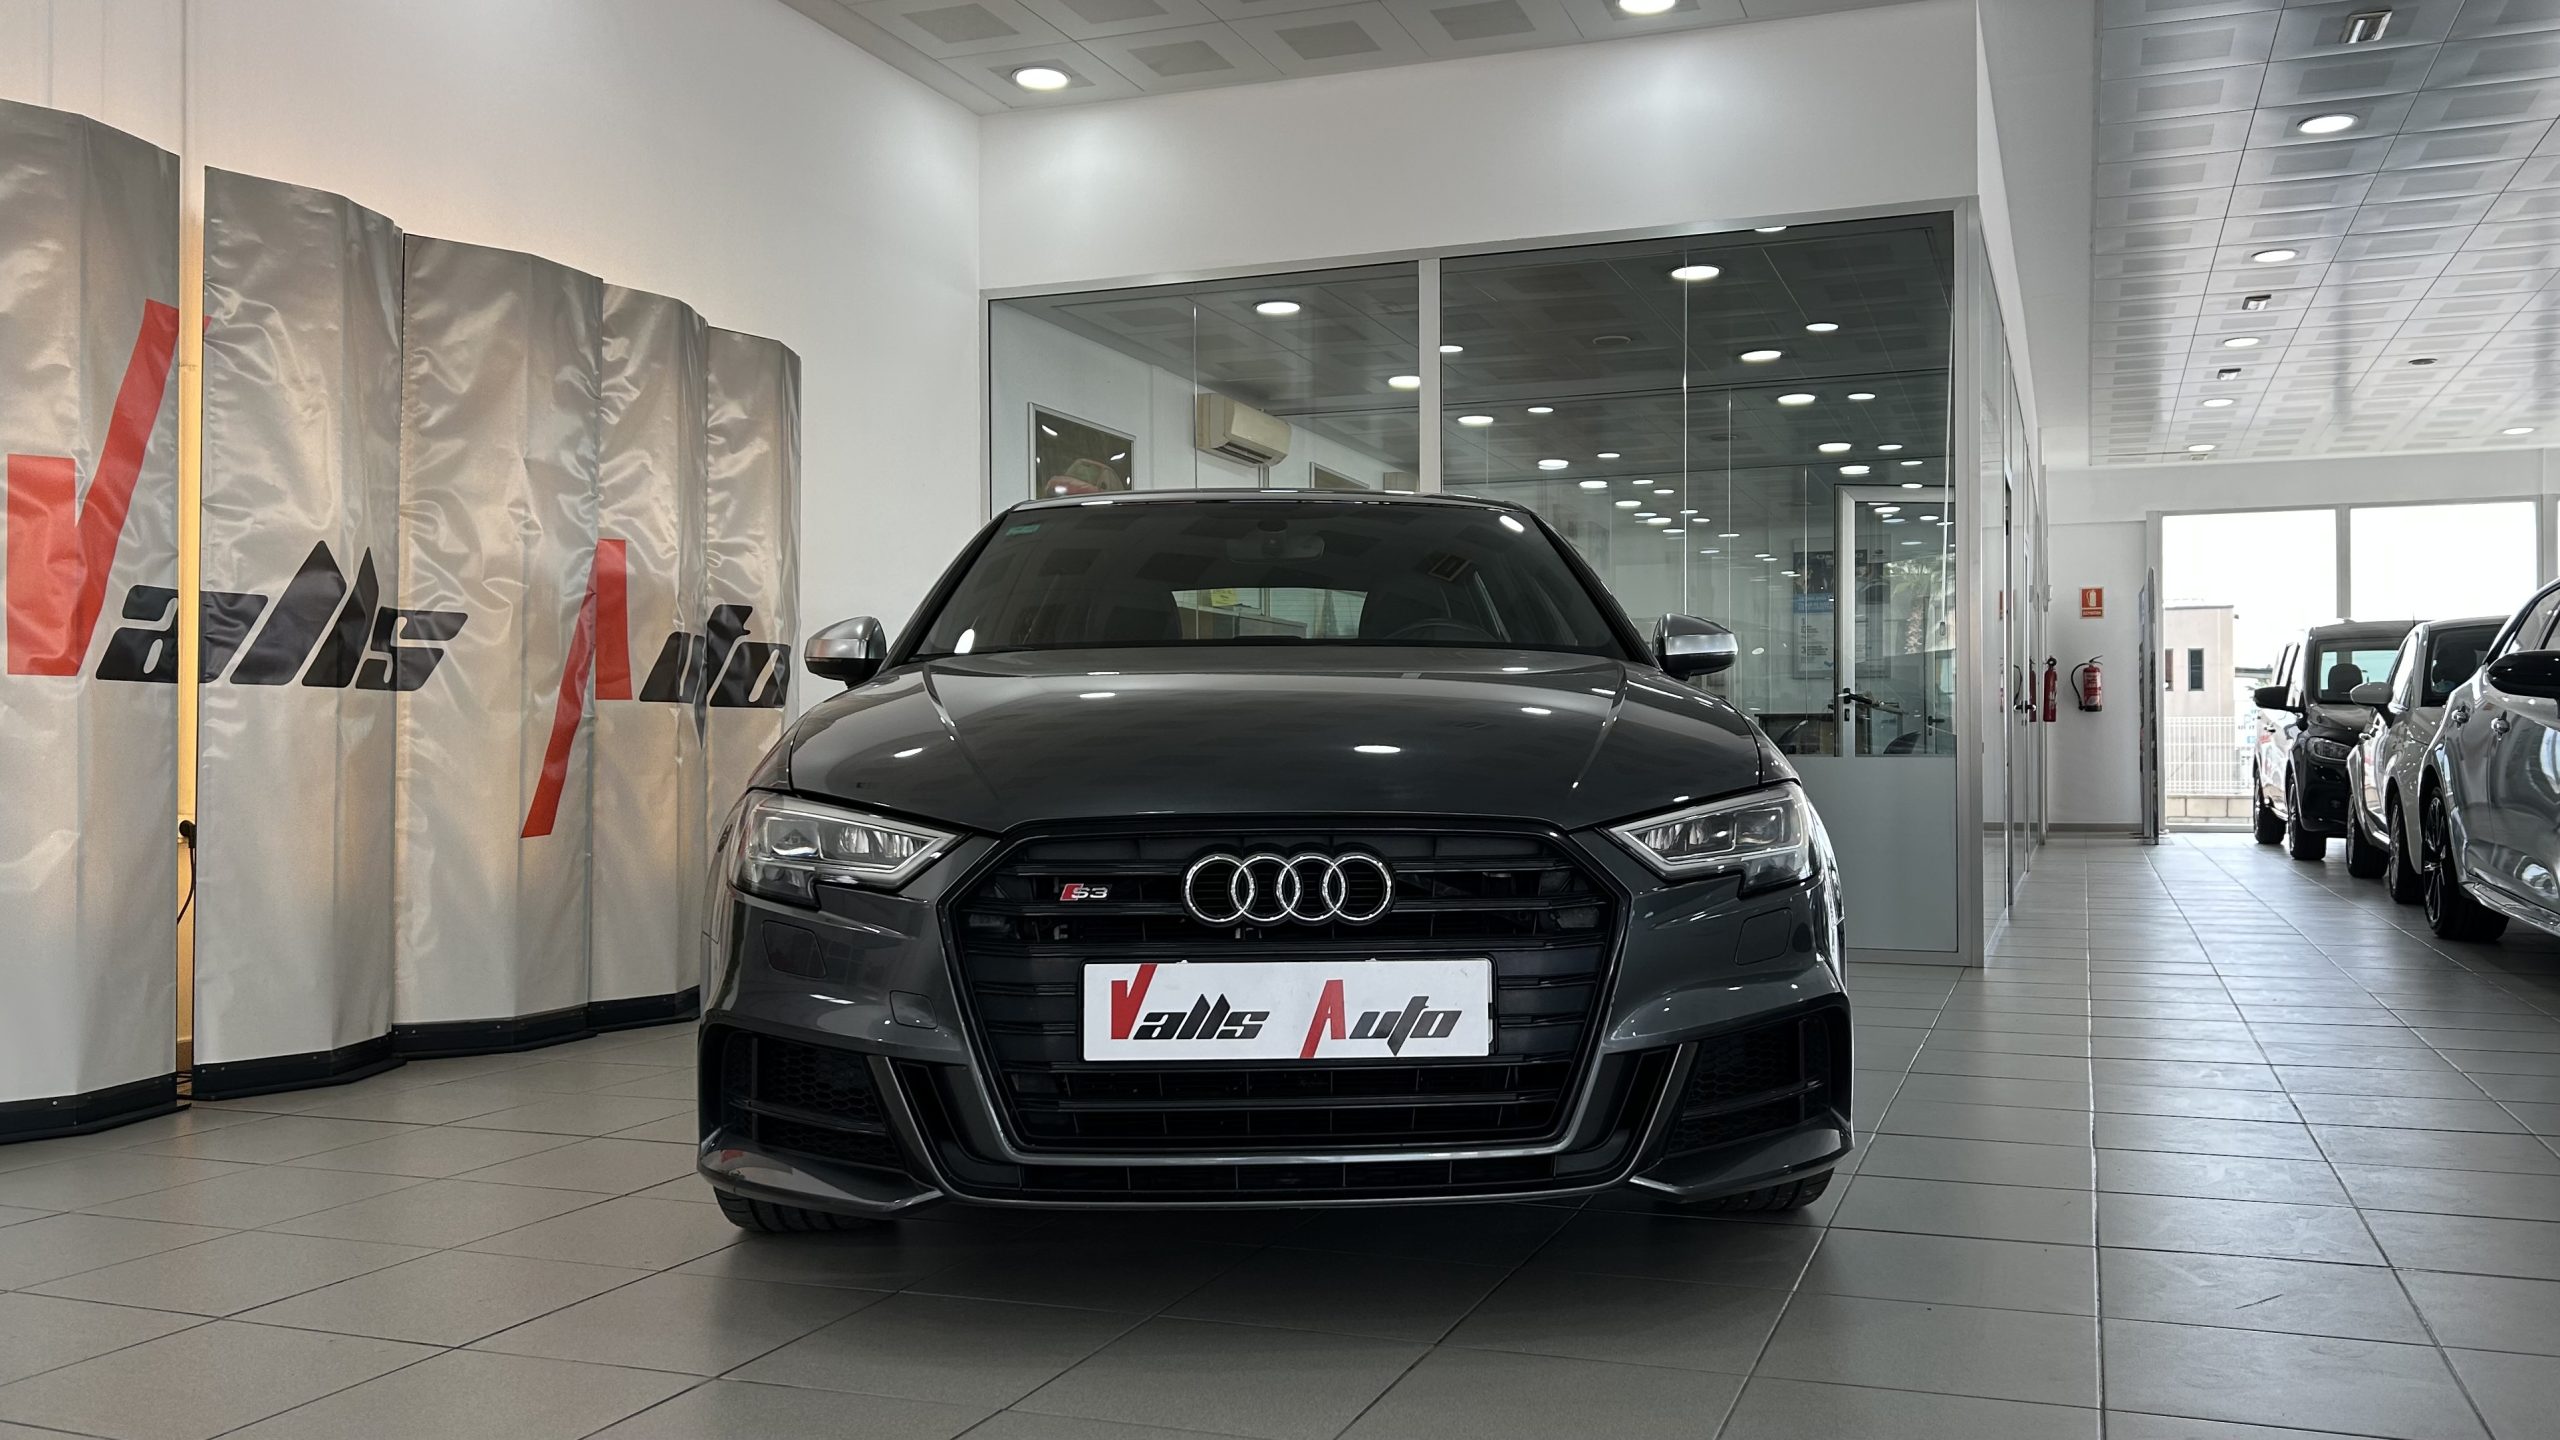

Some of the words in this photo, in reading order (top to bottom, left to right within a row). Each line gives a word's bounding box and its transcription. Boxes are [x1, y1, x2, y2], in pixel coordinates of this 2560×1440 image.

[7, 299, 468, 692] Valls
[520, 538, 791, 838] Auto
[1069, 885, 1109, 900] S3
[1111, 963, 1270, 1041] Valls
[1300, 979, 1463, 1059] Auto
